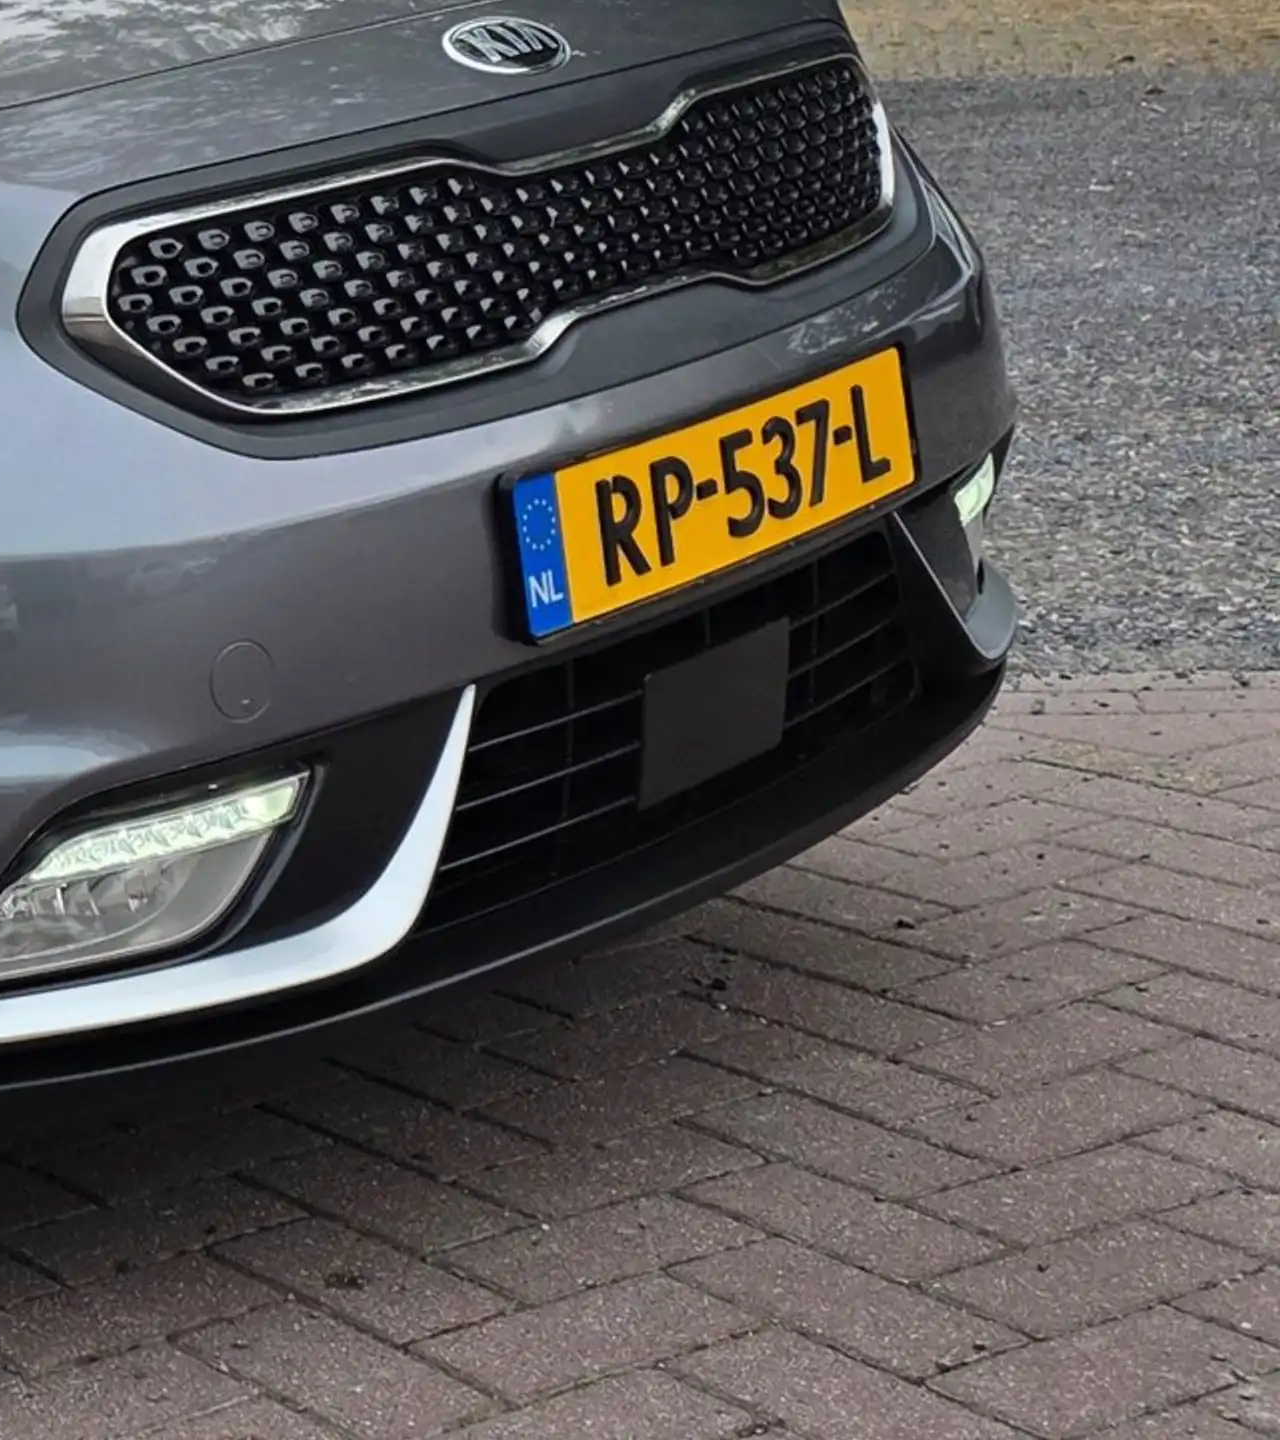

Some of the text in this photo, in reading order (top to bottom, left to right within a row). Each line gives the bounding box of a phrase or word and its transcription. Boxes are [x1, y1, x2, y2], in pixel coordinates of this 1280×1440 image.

[457, 20, 559, 63] KIA
[595, 383, 891, 588] RP-537-L
[528, 570, 564, 610] NL
